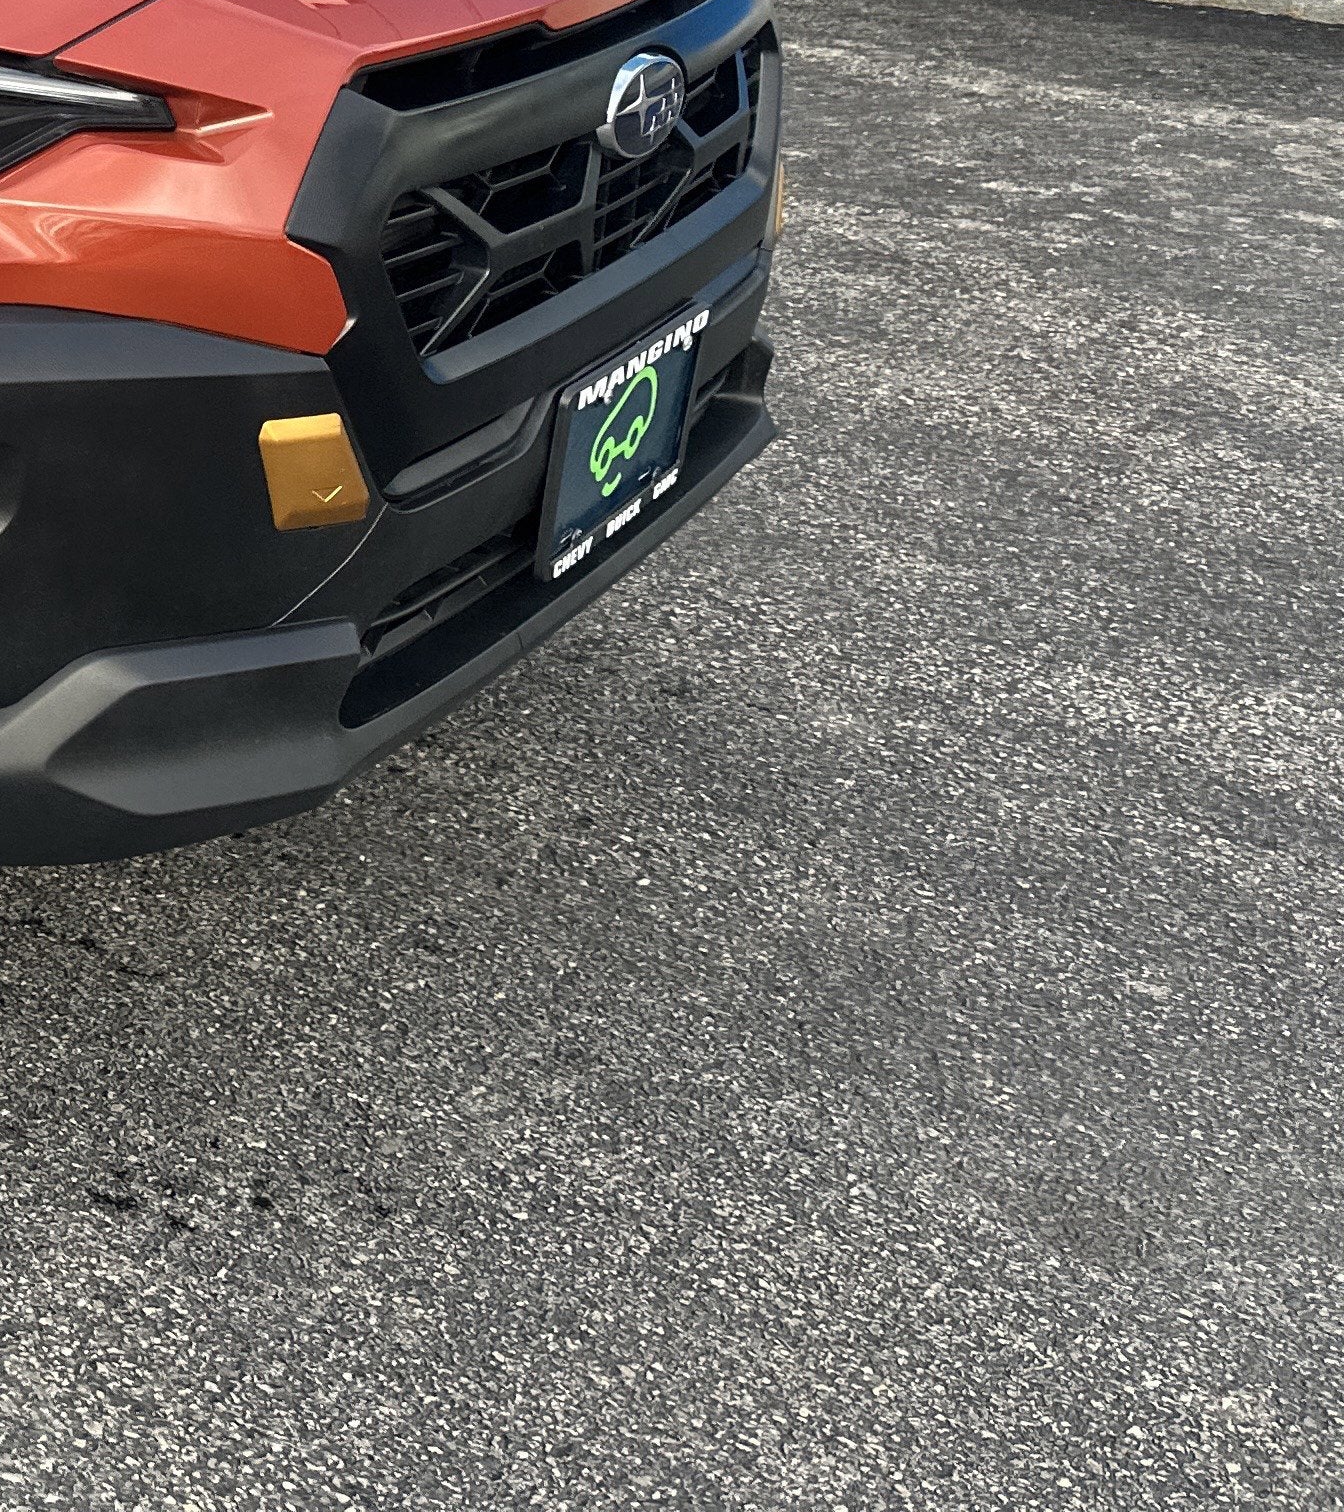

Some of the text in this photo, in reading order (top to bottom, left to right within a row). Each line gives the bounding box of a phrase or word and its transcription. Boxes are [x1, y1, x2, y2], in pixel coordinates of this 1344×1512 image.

[577, 309, 710, 410] MANGINO
[553, 536, 594, 579] CHEVY
[606, 498, 642, 538] BUICK
